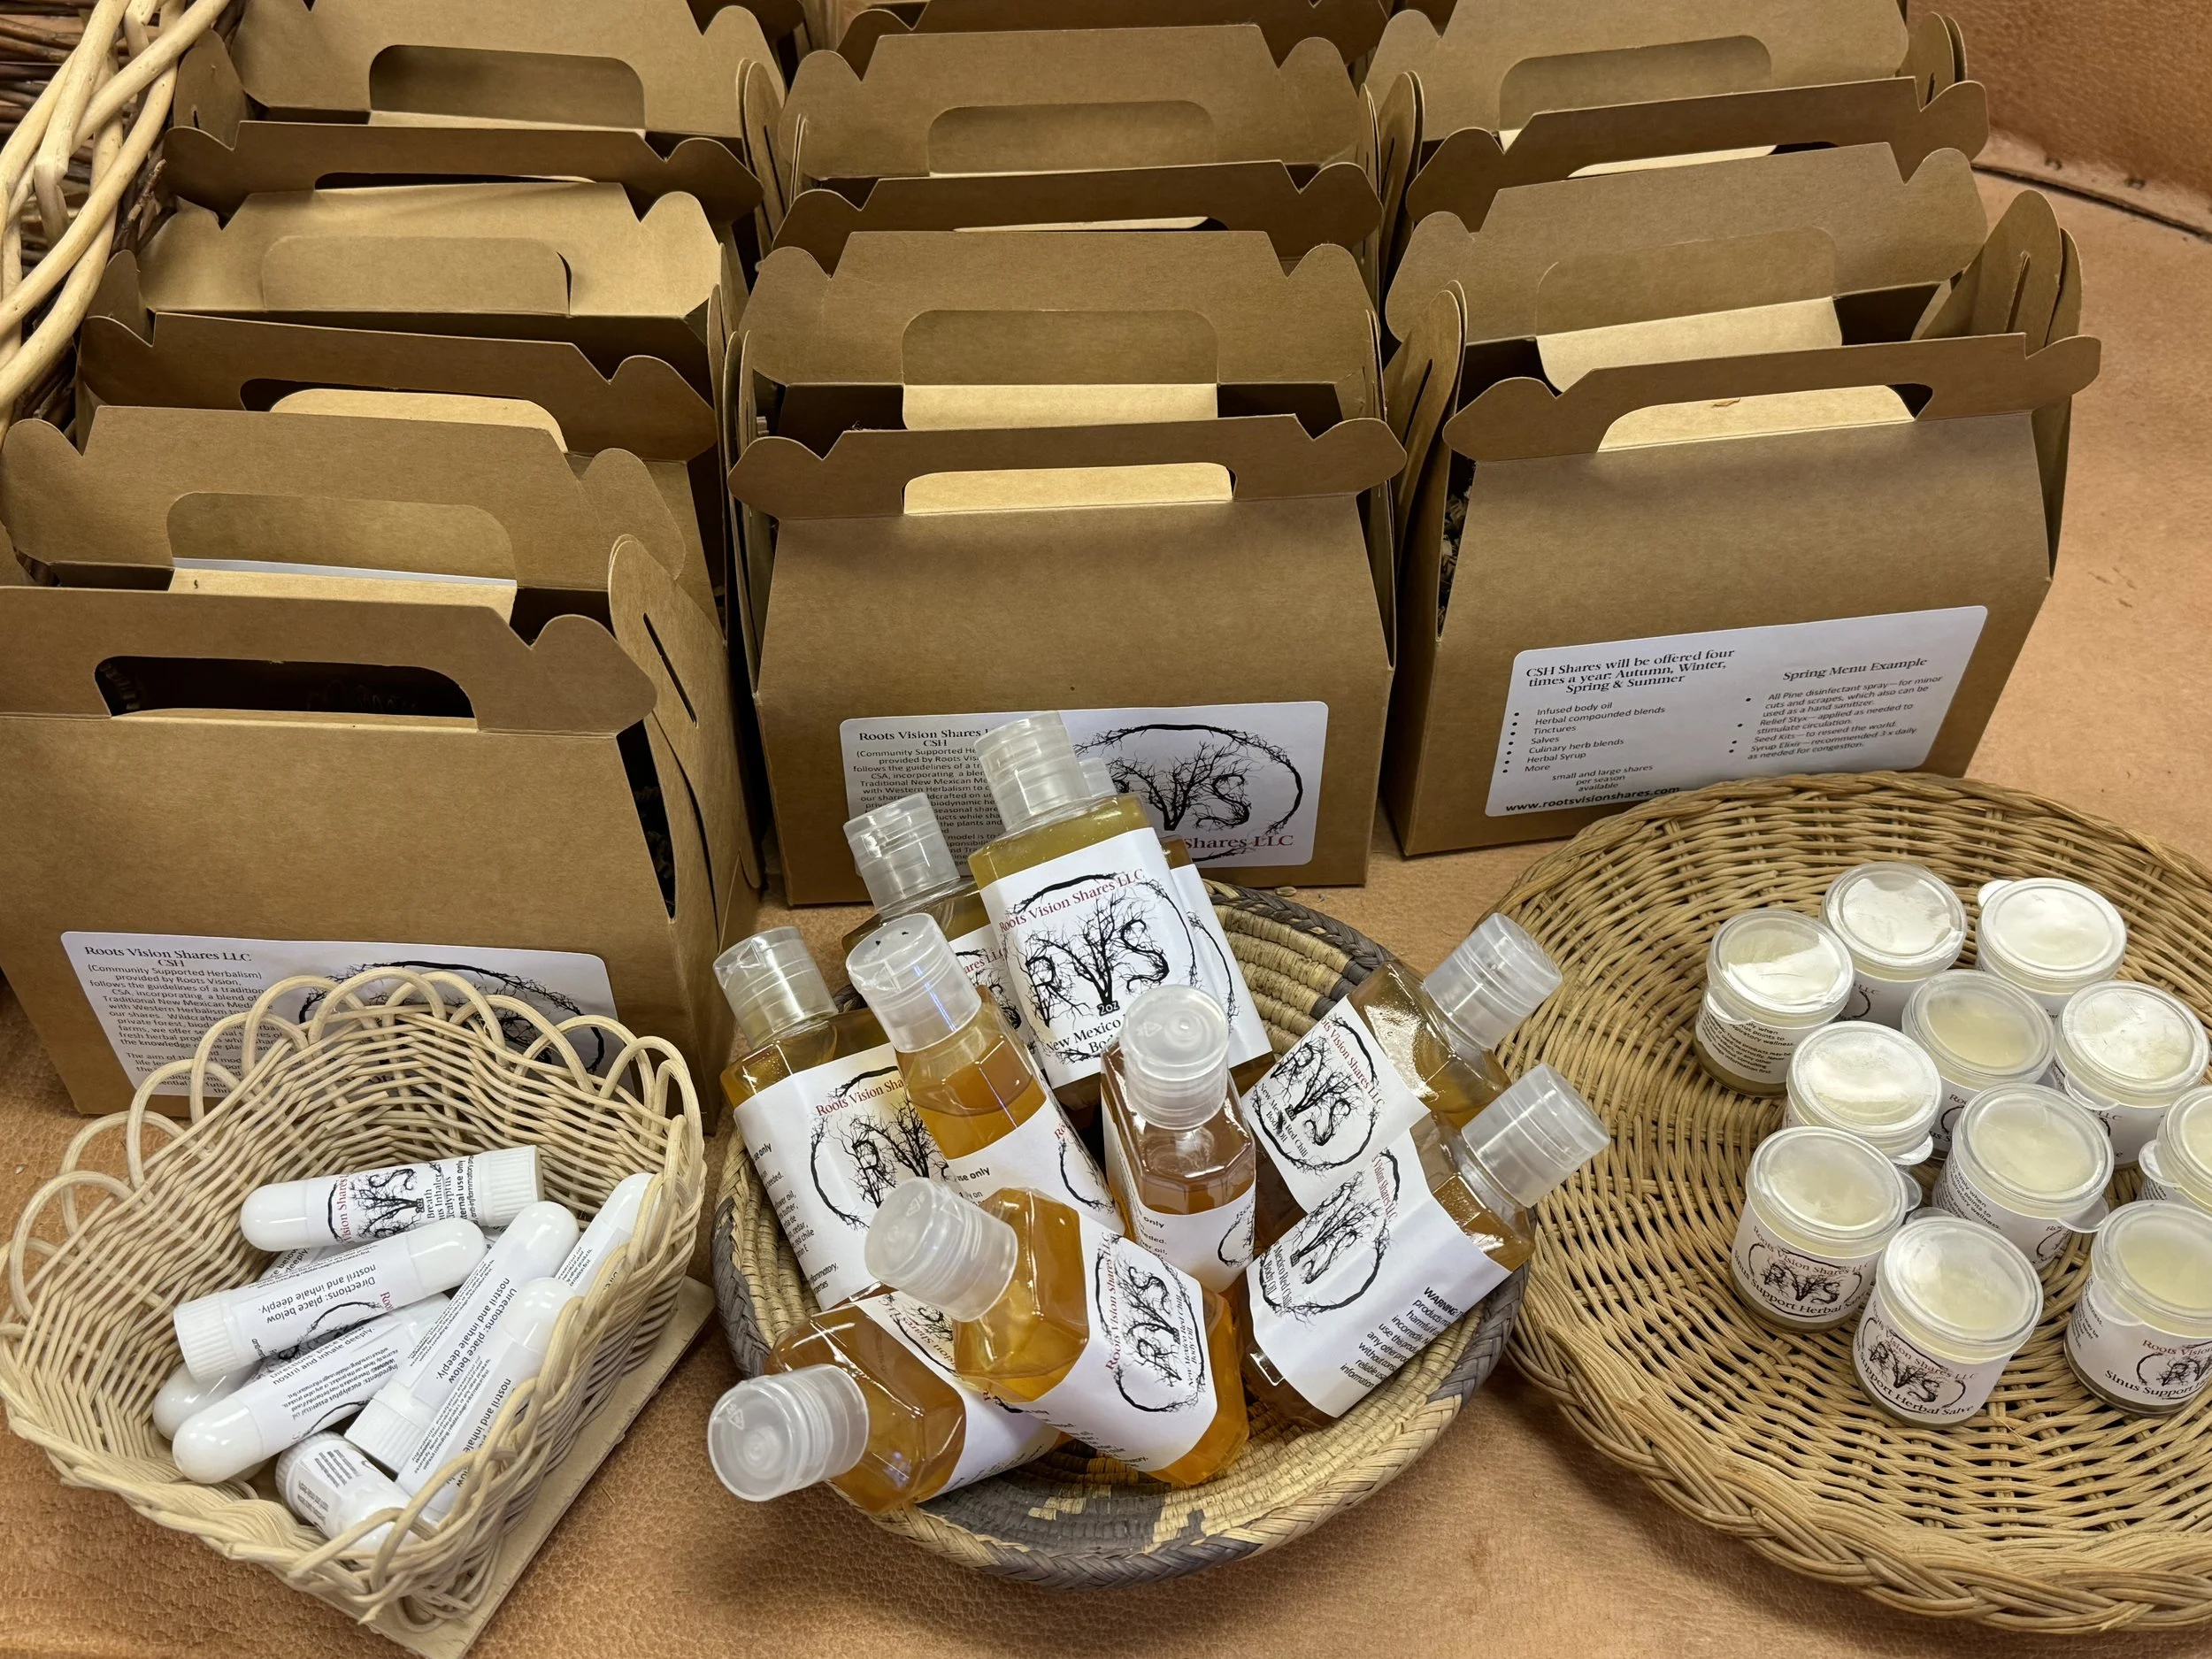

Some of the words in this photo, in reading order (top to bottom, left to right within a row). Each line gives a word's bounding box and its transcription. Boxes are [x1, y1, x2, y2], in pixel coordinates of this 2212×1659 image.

[1526, 666, 1555, 677] CSH
[1558, 664, 1601, 674] Shares
[1606, 658, 1630, 669] will
[1634, 657, 1650, 666] be
[1654, 651, 1701, 664] offered
[1705, 649, 1735, 659] four
[1783, 670, 1827, 681] Spring
[1829, 665, 1867, 675] Menu
[1870, 658, 1927, 671] Example
[1529, 678, 1564, 687] times
[1580, 672, 1612, 684] year:
[1616, 667, 1673, 679] Autumn,
[1679, 661, 1726, 672] Winter,
[1566, 682, 1610, 695] Spring
[1627, 675, 1685, 687] Summer
[1535, 716, 1566, 725] Herbal
[1568, 710, 1632, 722] compounded
[1537, 706, 1572, 715] Infused
[1574, 703, 1598, 712] body
[941, 729, 981, 738] Shares
[1534, 726, 1576, 734] Tinctures
[915, 748, 963, 757] Supported
[1593, 739, 1624, 748] blends
[853, 764, 886, 772] follows
[906, 763, 951, 772] guidelines
[879, 757, 919, 765] provided
[1527, 754, 1558, 763] Herbal
[1578, 782, 1618, 792] available
[1506, 787, 1680, 811] www.rootsvisionshares.com
[1253, 834, 1293, 848] LLC
[999, 911, 1026, 933] Roots
[1028, 899, 1071, 918] Vision
[1072, 878, 1115, 903] Shares
[1118, 869, 1145, 887] LLC
[85, 947, 125, 956] Roots
[127, 949, 172, 958] Vision
[174, 950, 219, 960] Shares
[223, 952, 251, 961] LLC
[88, 964, 149, 975] (Community
[151, 968, 205, 978] Supported
[207, 970, 262, 979] Herbalism)
[963, 957, 985, 974] ares
[1098, 999, 1120, 1016] 2oz
[1046, 1037, 1070, 1053] New
[1073, 1019, 1121, 1043] Mexico
[1318, 1016, 1334, 1032] ots
[1331, 1028, 1349, 1059] Vision
[1348, 1057, 1371, 1089] Shares
[1368, 1087, 1385, 1109] LLC
[816, 1094, 849, 1116] Roots
[849, 1087, 884, 1103] Vision
[884, 1079, 904, 1093] Sha
[1258, 1083, 1271, 1100] New
[1285, 1124, 1297, 1140] Red
[1294, 1140, 1308, 1157] Chili
[970, 1167, 990, 1179] only
[1373, 1158, 1386, 1184] Vision
[433, 1172, 442, 1206] Inhaler
[1379, 1179, 1393, 1207] Shares
[424, 1189, 435, 1218] Breath
[1385, 1202, 1397, 1222] LLC
[1143, 1217, 1164, 1228] only
[326, 1277, 344, 1290] and
[346, 1264, 376, 1282] nostril
[1105, 1258, 1116, 1292] Shares
[296, 1285, 325, 1300] inhale
[325, 1277, 375, 1301] Directions:
[489, 1278, 510, 1306] nostril
[1751, 1279, 1795, 1310] Support
[258, 1296, 294, 1314] deeply.
[297, 1294, 323, 1311] place
[1412, 1300, 1442, 1323] products
[1424, 1286, 1458, 1317] WARNING:
[267, 1308, 296, 1324] below
[477, 1305, 491, 1323] and
[1110, 1296, 1118, 1330] Vision
[458, 1323, 480, 1348] inhale
[466, 1332, 485, 1356] place
[1367, 1332, 1380, 1347] any
[1379, 1324, 1393, 1337] use
[1391, 1334, 1403, 1346] this
[1105, 1335, 1121, 1370] Roots
[2142, 1340, 2177, 1355] Roots
[436, 1349, 460, 1379] deeply.
[449, 1356, 471, 1384] below
[1860, 1352, 1893, 1395] Support
[1895, 1394, 1939, 1414] Herbal
[2105, 1370, 2139, 1391] Sinus
[2143, 1386, 2191, 1397] Support
